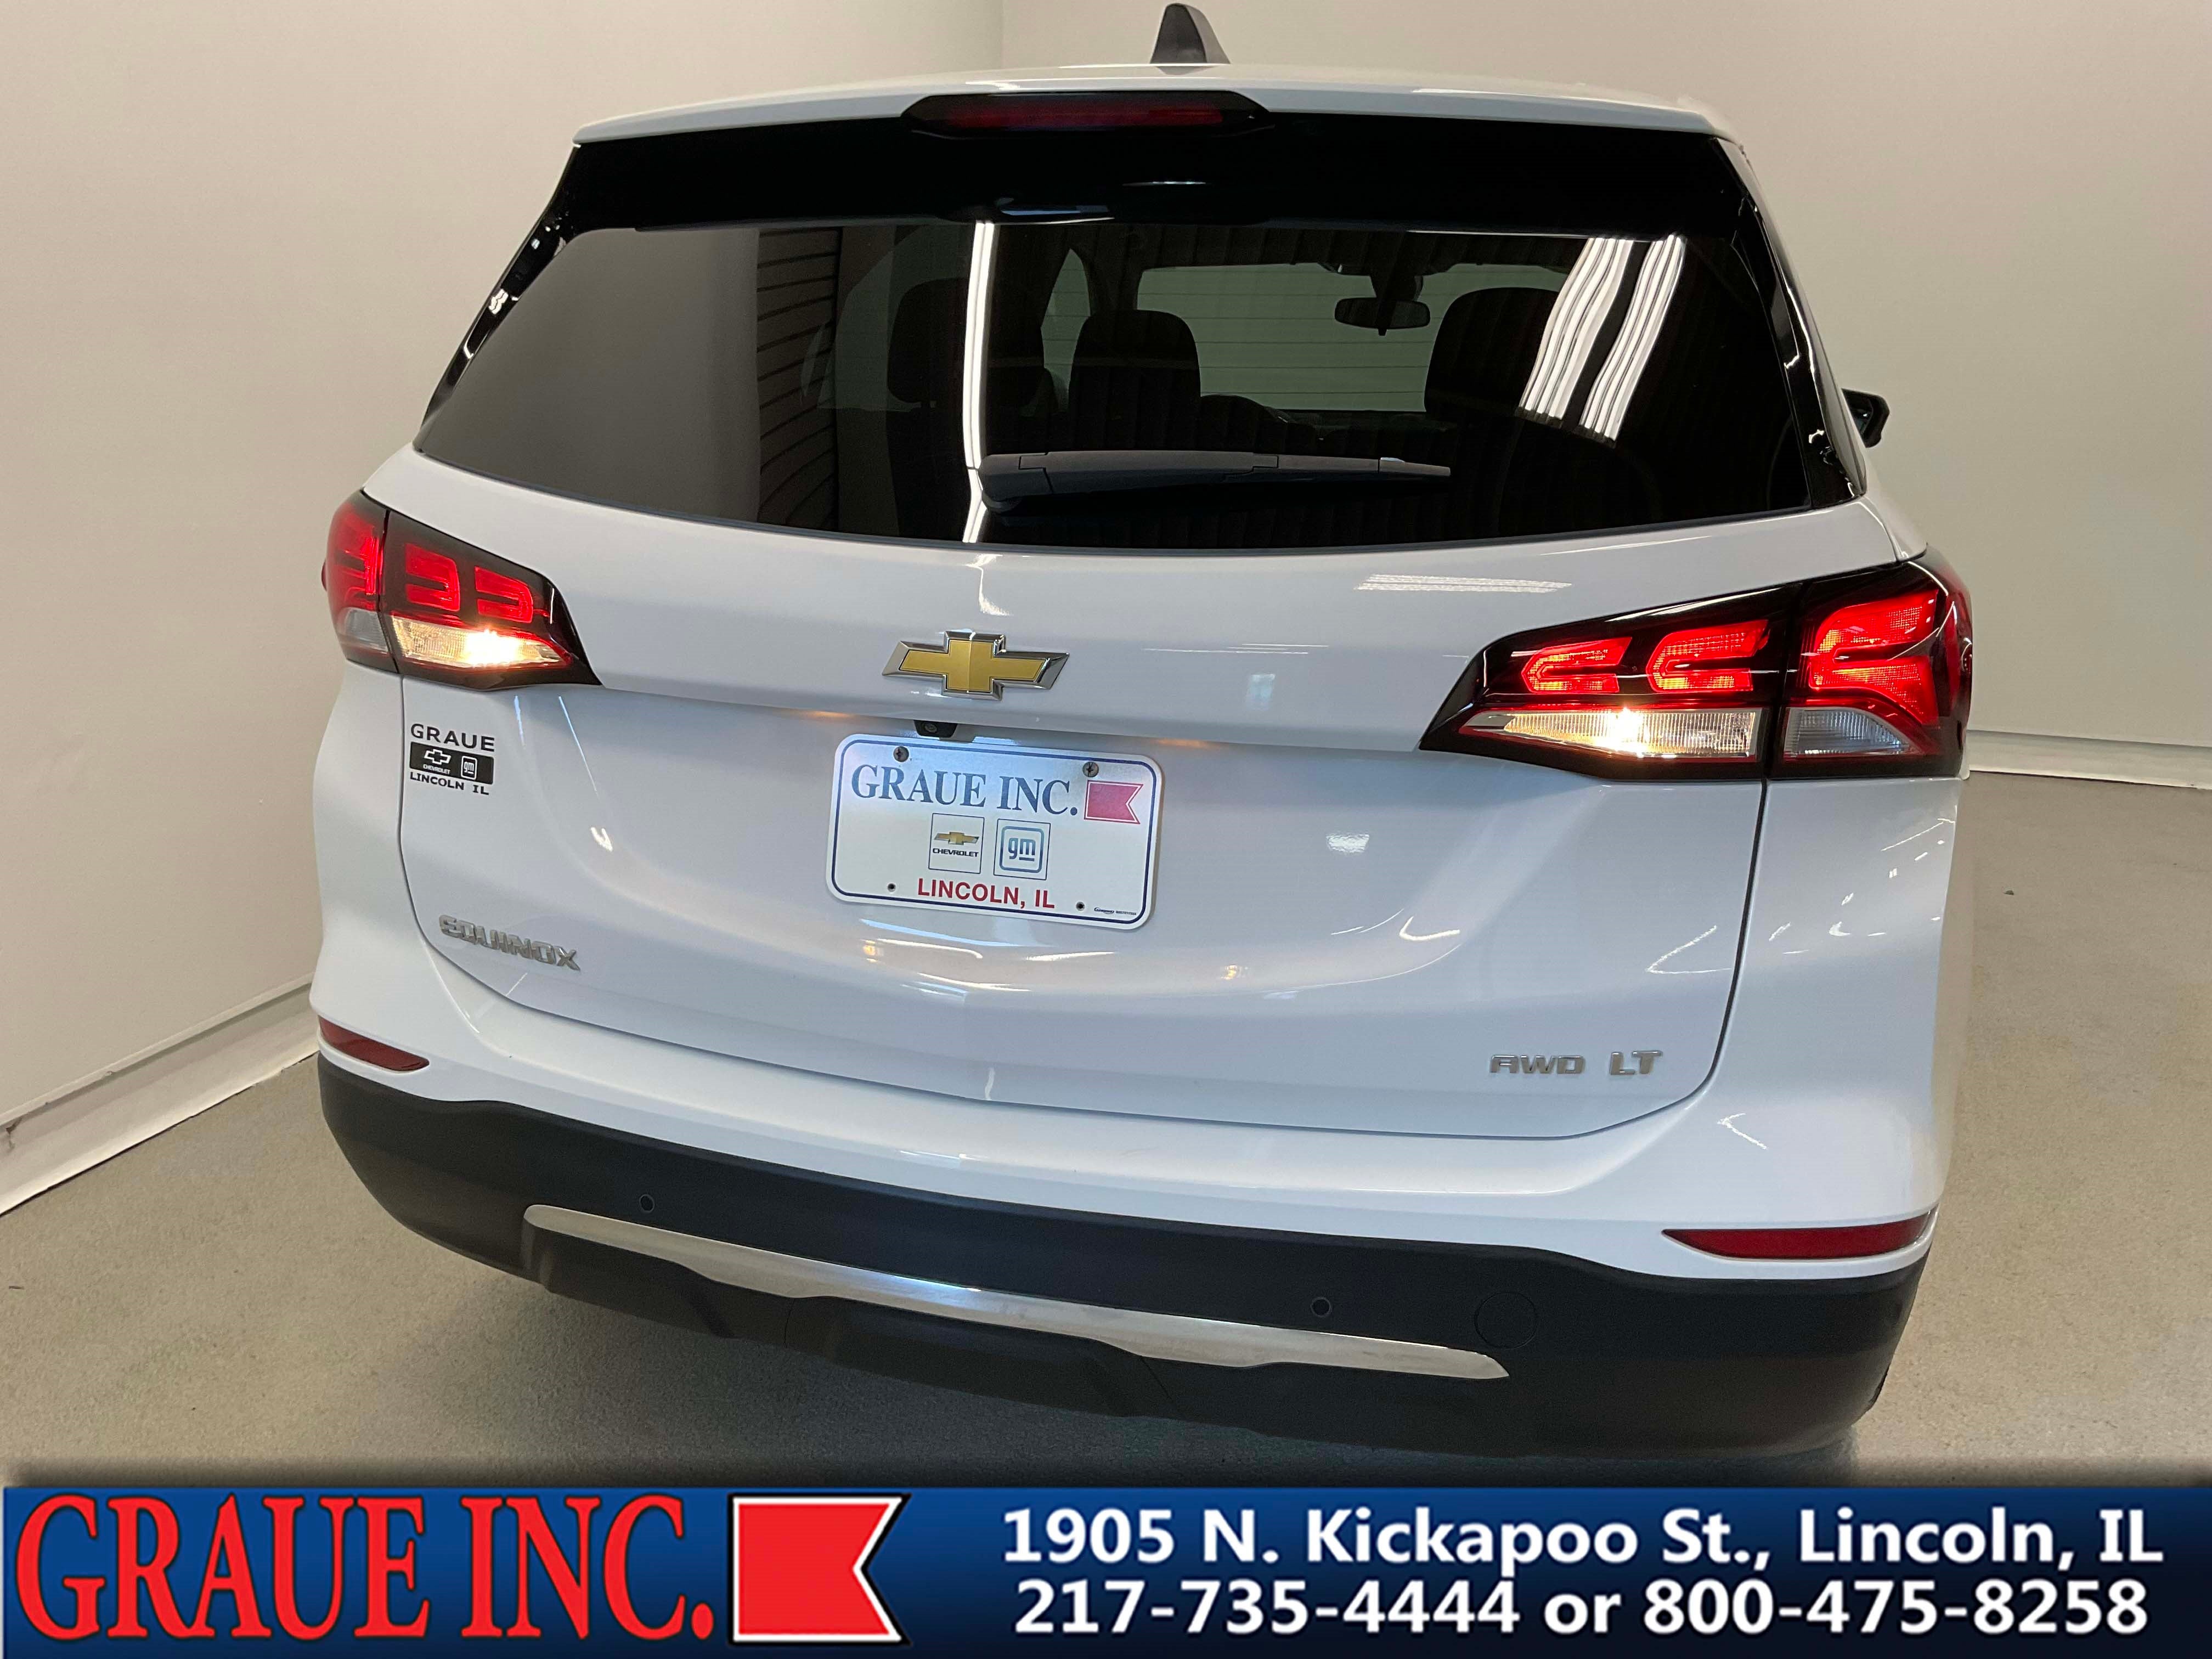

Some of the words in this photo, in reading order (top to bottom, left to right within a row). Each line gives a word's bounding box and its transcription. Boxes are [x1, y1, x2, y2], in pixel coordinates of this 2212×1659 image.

[411, 724, 495, 752] GRAUE
[410, 771, 464, 791] LINCOLN
[472, 785, 489, 795] IL
[423, 764, 451, 775] CHEVROLET
[851, 764, 986, 808] GRAUE
[997, 775, 1078, 816] INC.
[932, 847, 979, 857] CHEVROLET
[1008, 837, 1036, 861] gm
[917, 878, 1026, 910] LINCOLN,
[1035, 889, 1055, 909] IL
[439, 915, 580, 970] EQUINOX
[1489, 1054, 1585, 1074] AWD
[1609, 1049, 1663, 1076] LT
